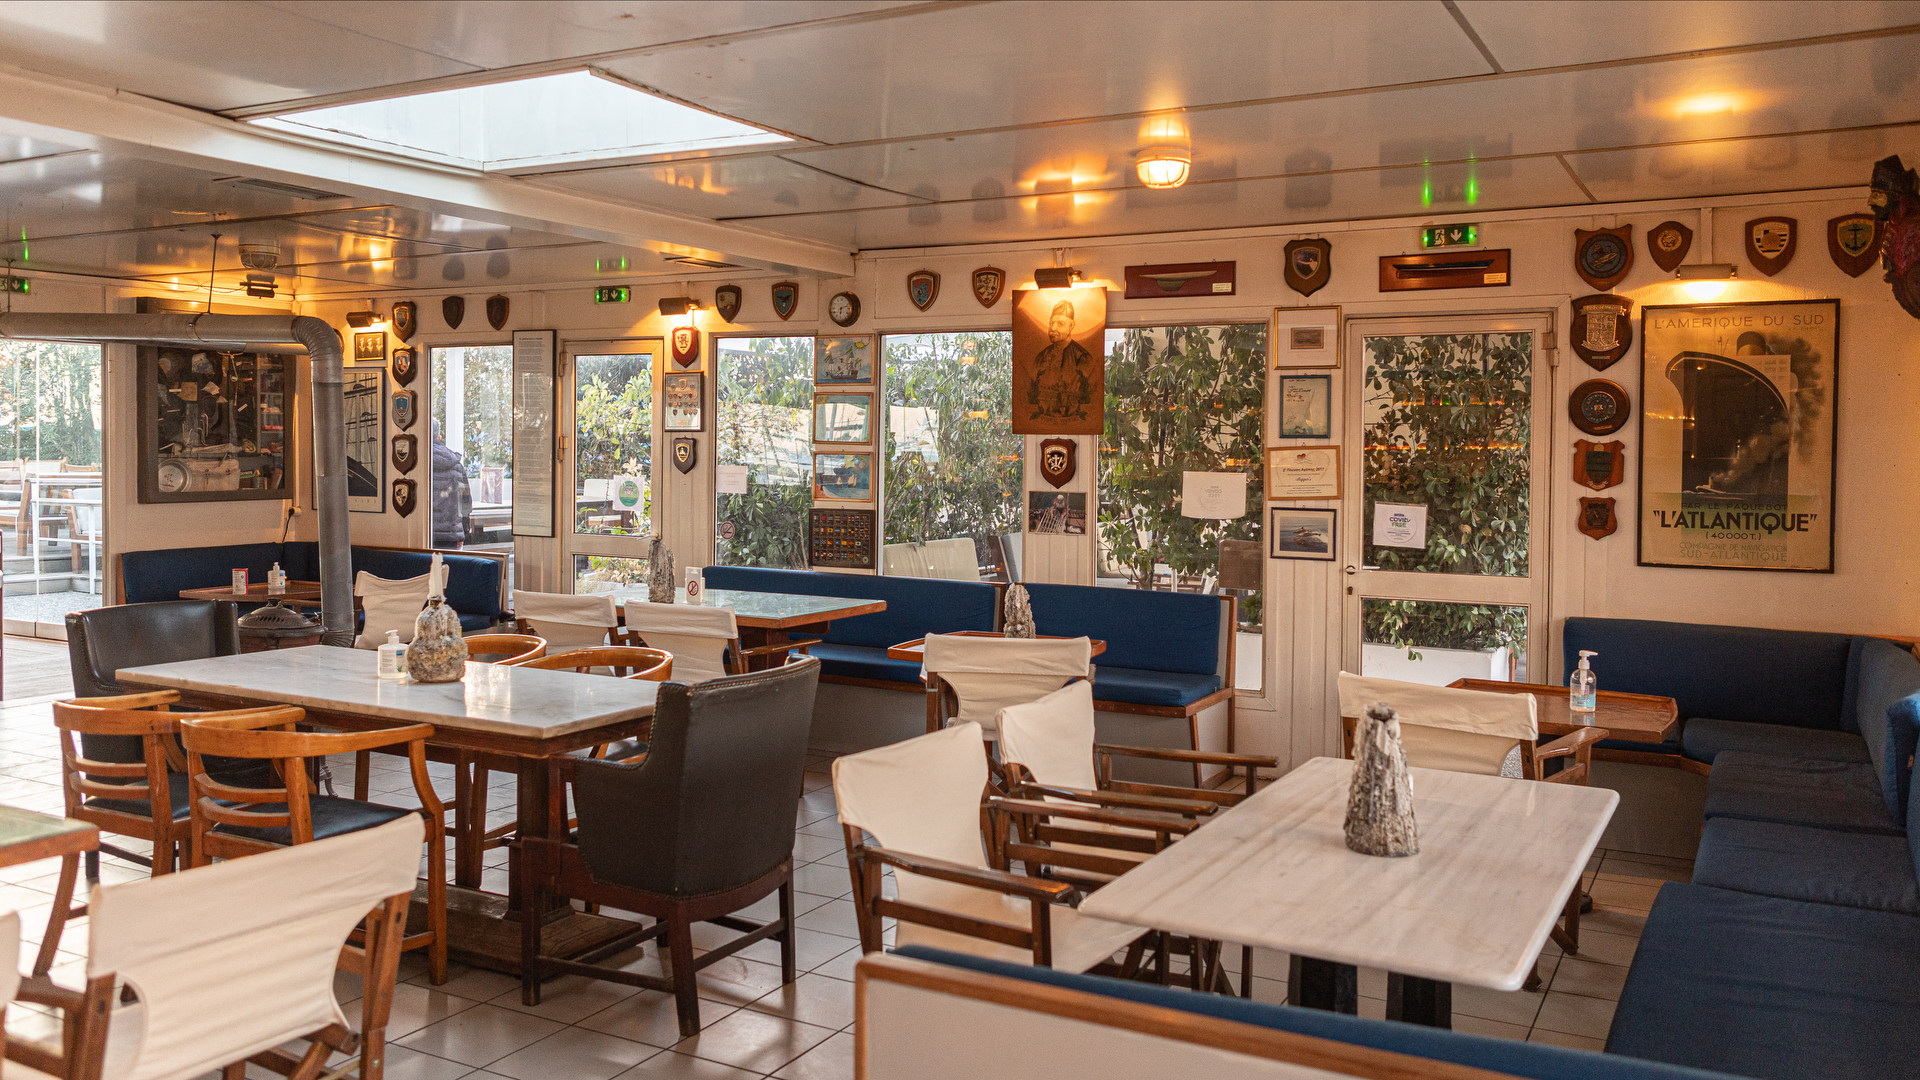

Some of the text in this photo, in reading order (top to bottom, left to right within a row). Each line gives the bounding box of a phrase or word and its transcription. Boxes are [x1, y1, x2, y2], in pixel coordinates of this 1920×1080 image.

[1654, 314, 1824, 330] L'AMERIQUE DU SUD
[1682, 502, 1788, 511] PAR LE PAQUEBOT
[1653, 510, 1817, 534] "L'ATLANTIQUE"
[1679, 541, 1727, 550] COMPAGNIE
[1741, 544, 1788, 552] NAVIGATION
[1679, 550, 1788, 562] SUD-ATLANTIQUE
